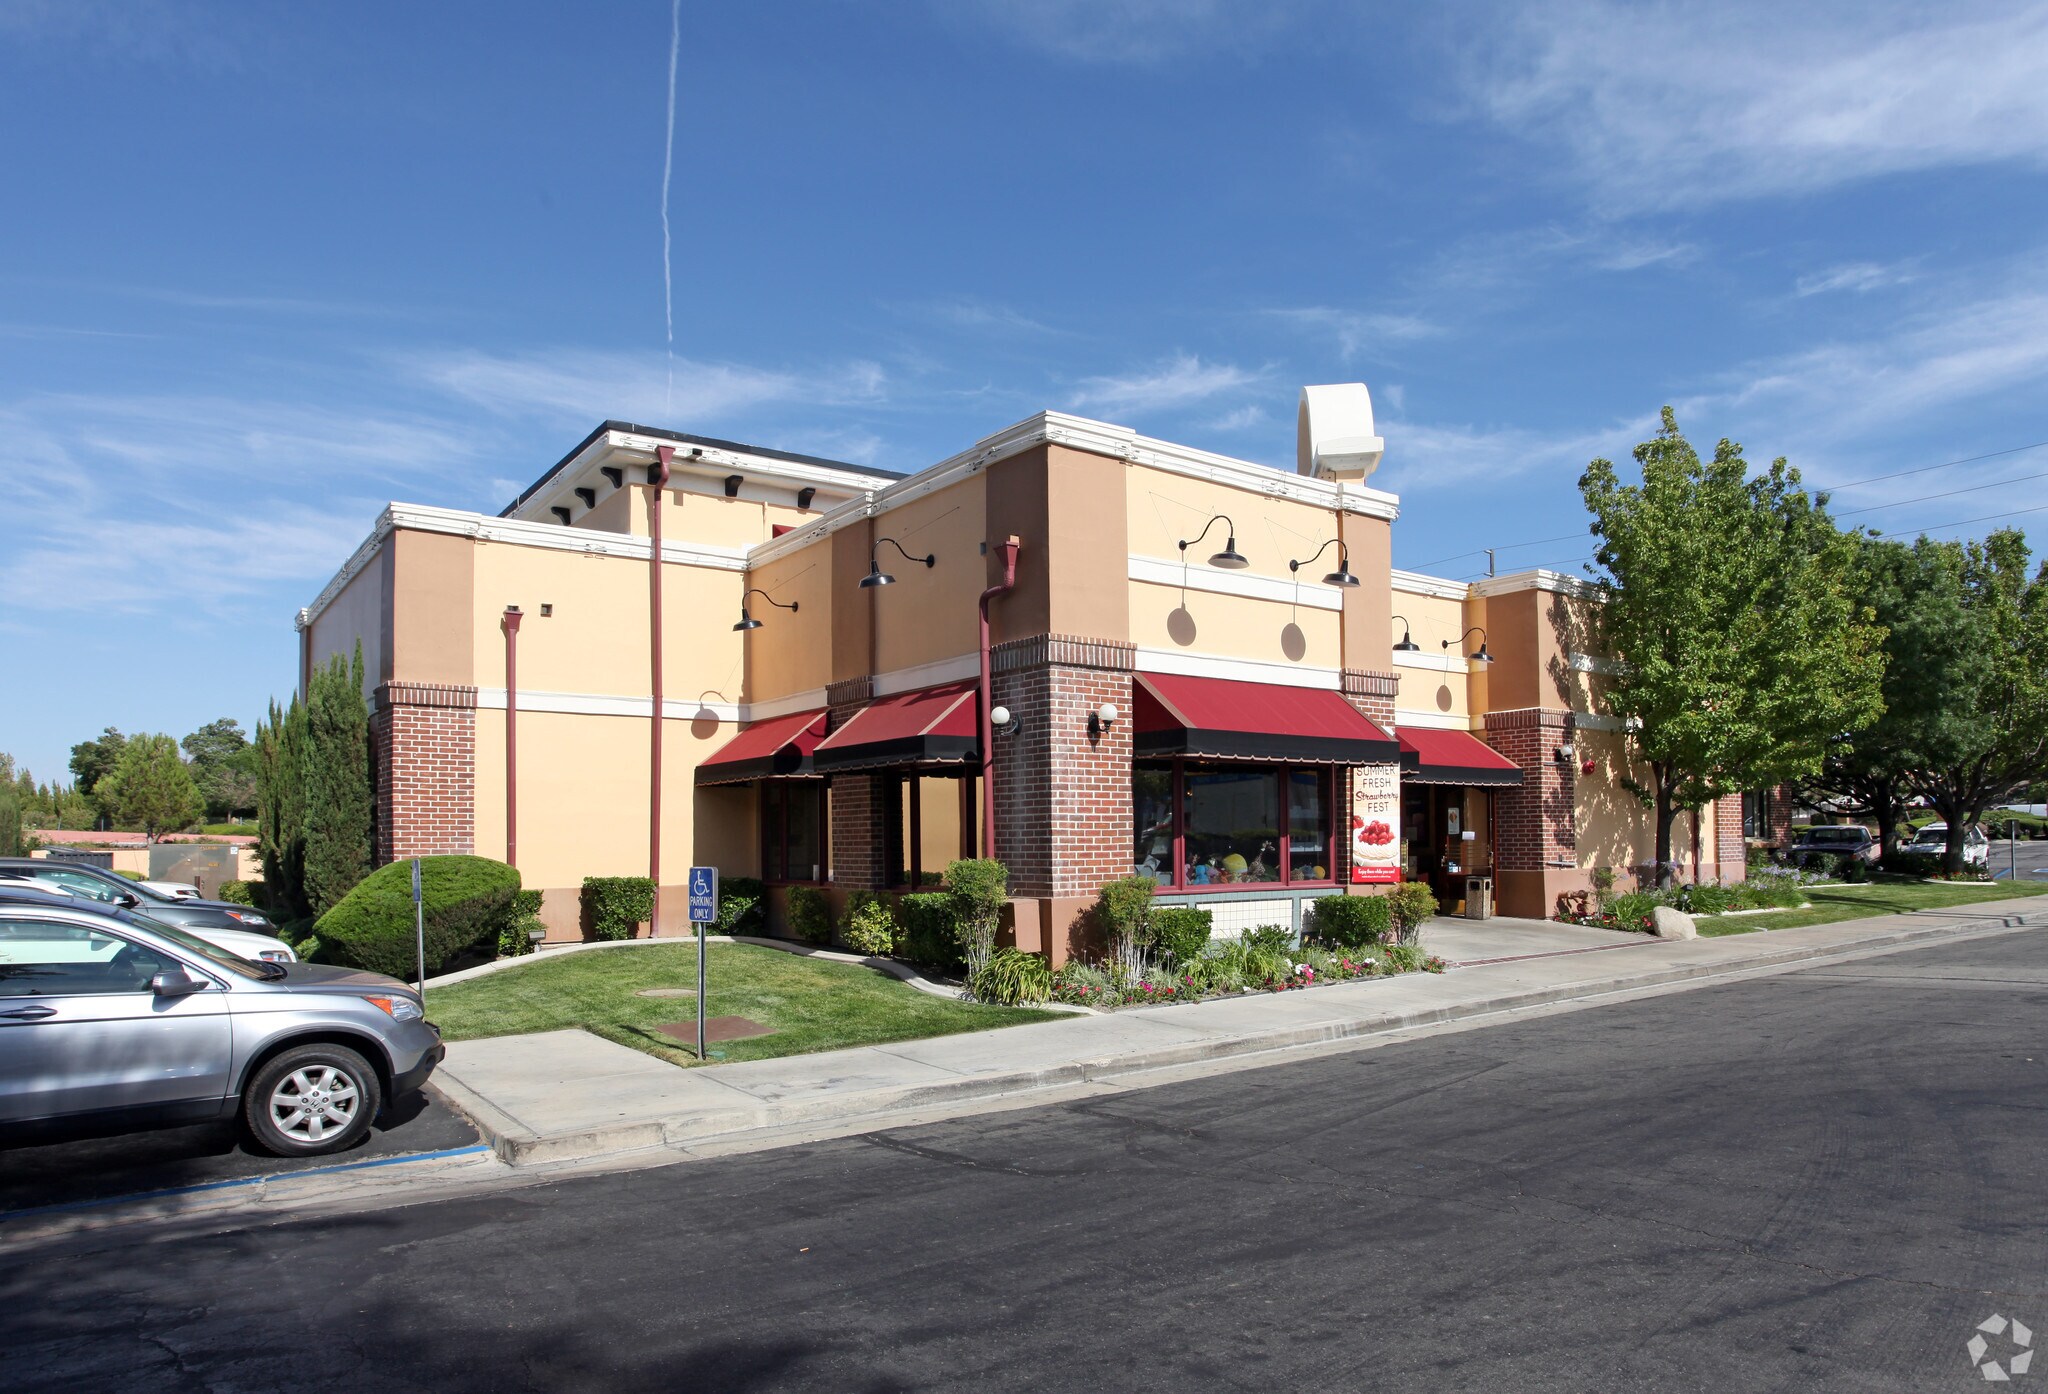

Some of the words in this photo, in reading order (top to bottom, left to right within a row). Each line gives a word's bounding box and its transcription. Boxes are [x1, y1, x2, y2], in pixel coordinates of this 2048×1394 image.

[1356, 766, 1396, 777] SUMMER
[1362, 777, 1392, 789] FRESH
[1355, 789, 1399, 802] Strawberry
[1367, 801, 1390, 813] FEST
[689, 896, 713, 907] PARKING
[694, 908, 709, 919] ONLY
